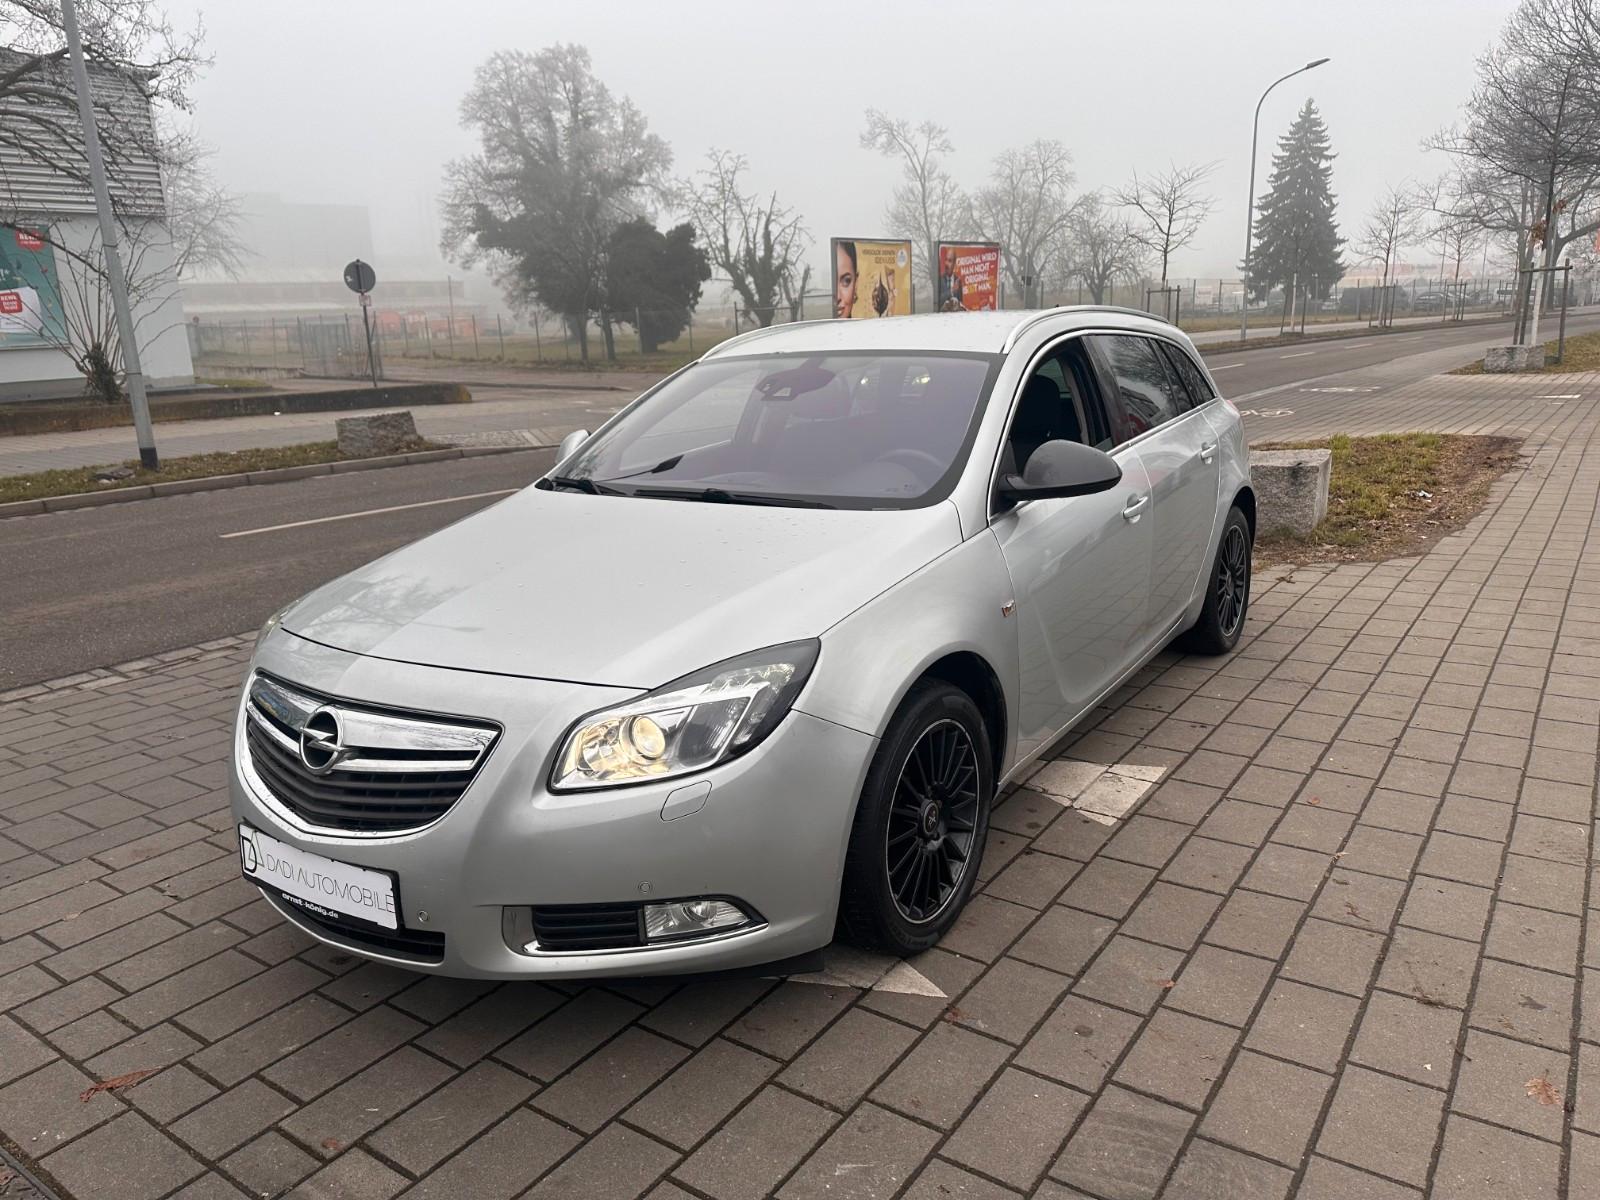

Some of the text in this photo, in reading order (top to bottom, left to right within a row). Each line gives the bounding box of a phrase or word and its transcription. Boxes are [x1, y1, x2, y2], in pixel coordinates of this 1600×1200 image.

[956, 252, 997, 265] ORIGINAL WIRD
[960, 265, 974, 275] MAN
[975, 262, 990, 272] NICHT
[964, 272, 989, 284] ORIGINAL
[266, 853, 396, 914] DADI AUTOMOBILE
[281, 892, 339, 919] ernst-könig.de
